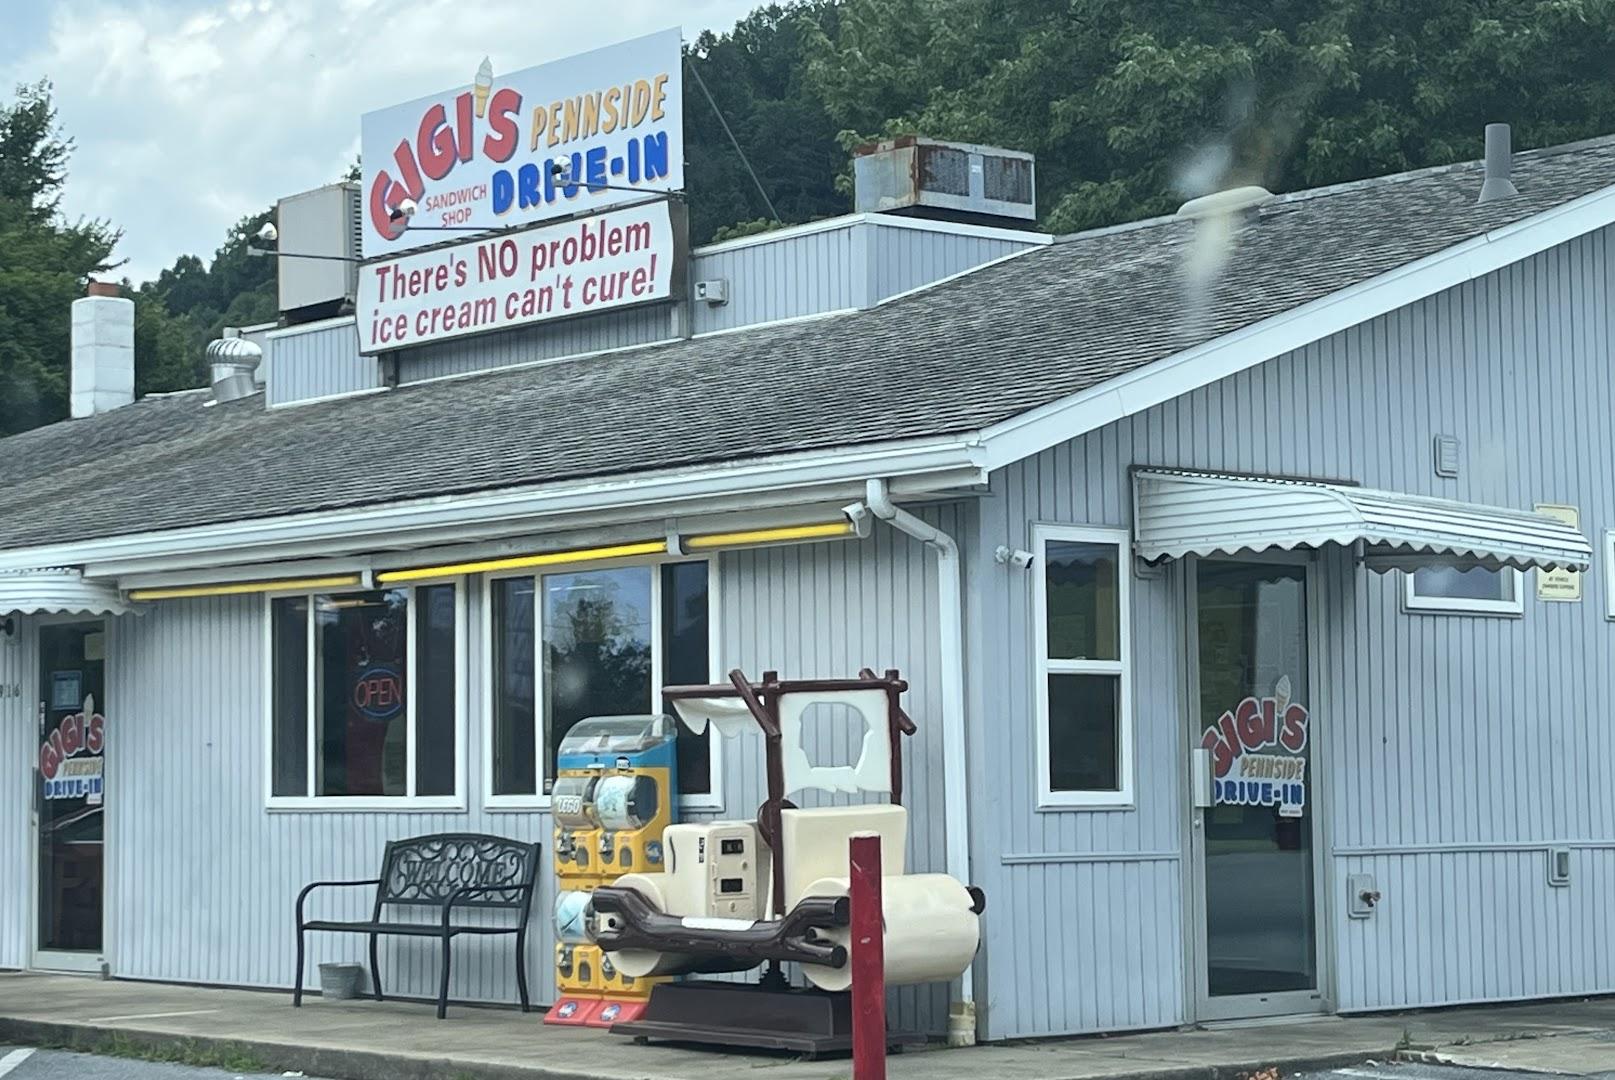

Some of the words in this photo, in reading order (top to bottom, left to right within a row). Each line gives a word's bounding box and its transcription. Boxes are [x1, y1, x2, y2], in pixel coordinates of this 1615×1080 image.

[531, 73, 669, 152] PENNSIDE
[370, 87, 523, 241] GIGI'S
[492, 130, 669, 216] DRIVE-IN
[425, 184, 488, 212] SANDWICH
[442, 207, 472, 227] SHOP
[376, 252, 468, 303] There's
[478, 239, 518, 282] NO
[531, 219, 651, 281] problem
[371, 309, 408, 345] ice
[415, 294, 497, 336] cream
[504, 274, 574, 320] can't
[582, 254, 658, 305] cure!
[355, 678, 402, 708] OPEN
[1240, 756, 1304, 780] PENNSIDE
[45, 778, 102, 797] DRIVE-IN
[557, 797, 581, 814] LEGO
[404, 860, 507, 887] WELCOME
